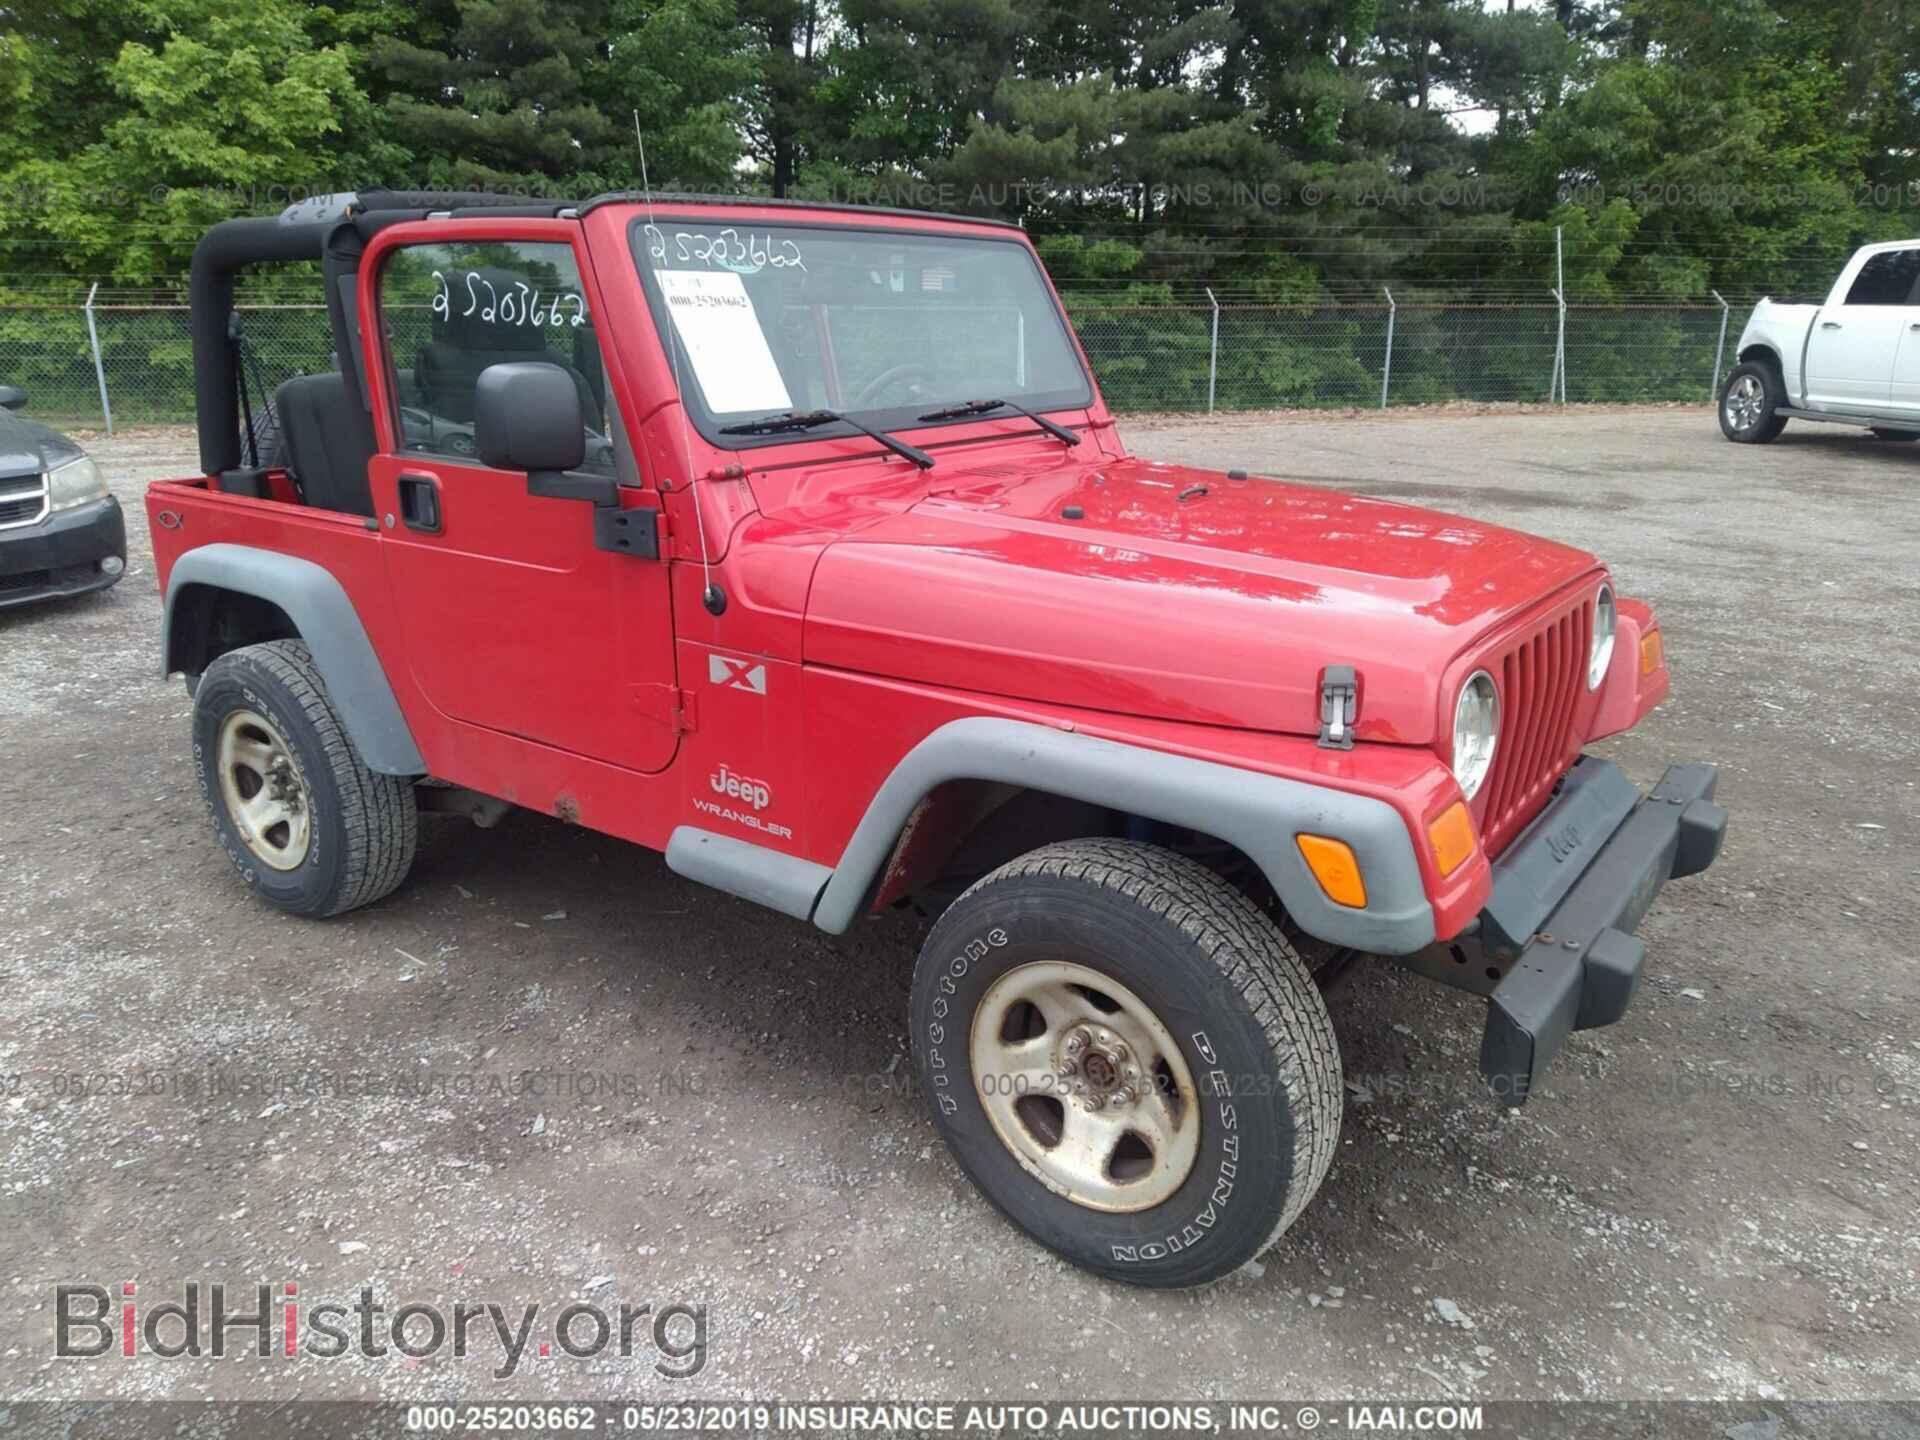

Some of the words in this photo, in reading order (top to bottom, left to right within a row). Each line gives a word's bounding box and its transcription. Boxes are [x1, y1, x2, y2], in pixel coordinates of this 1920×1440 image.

[709, 763, 771, 811] Jeep
[692, 797, 793, 840] WRANGLER
[1111, 1031, 1240, 1262] DESTINATION
